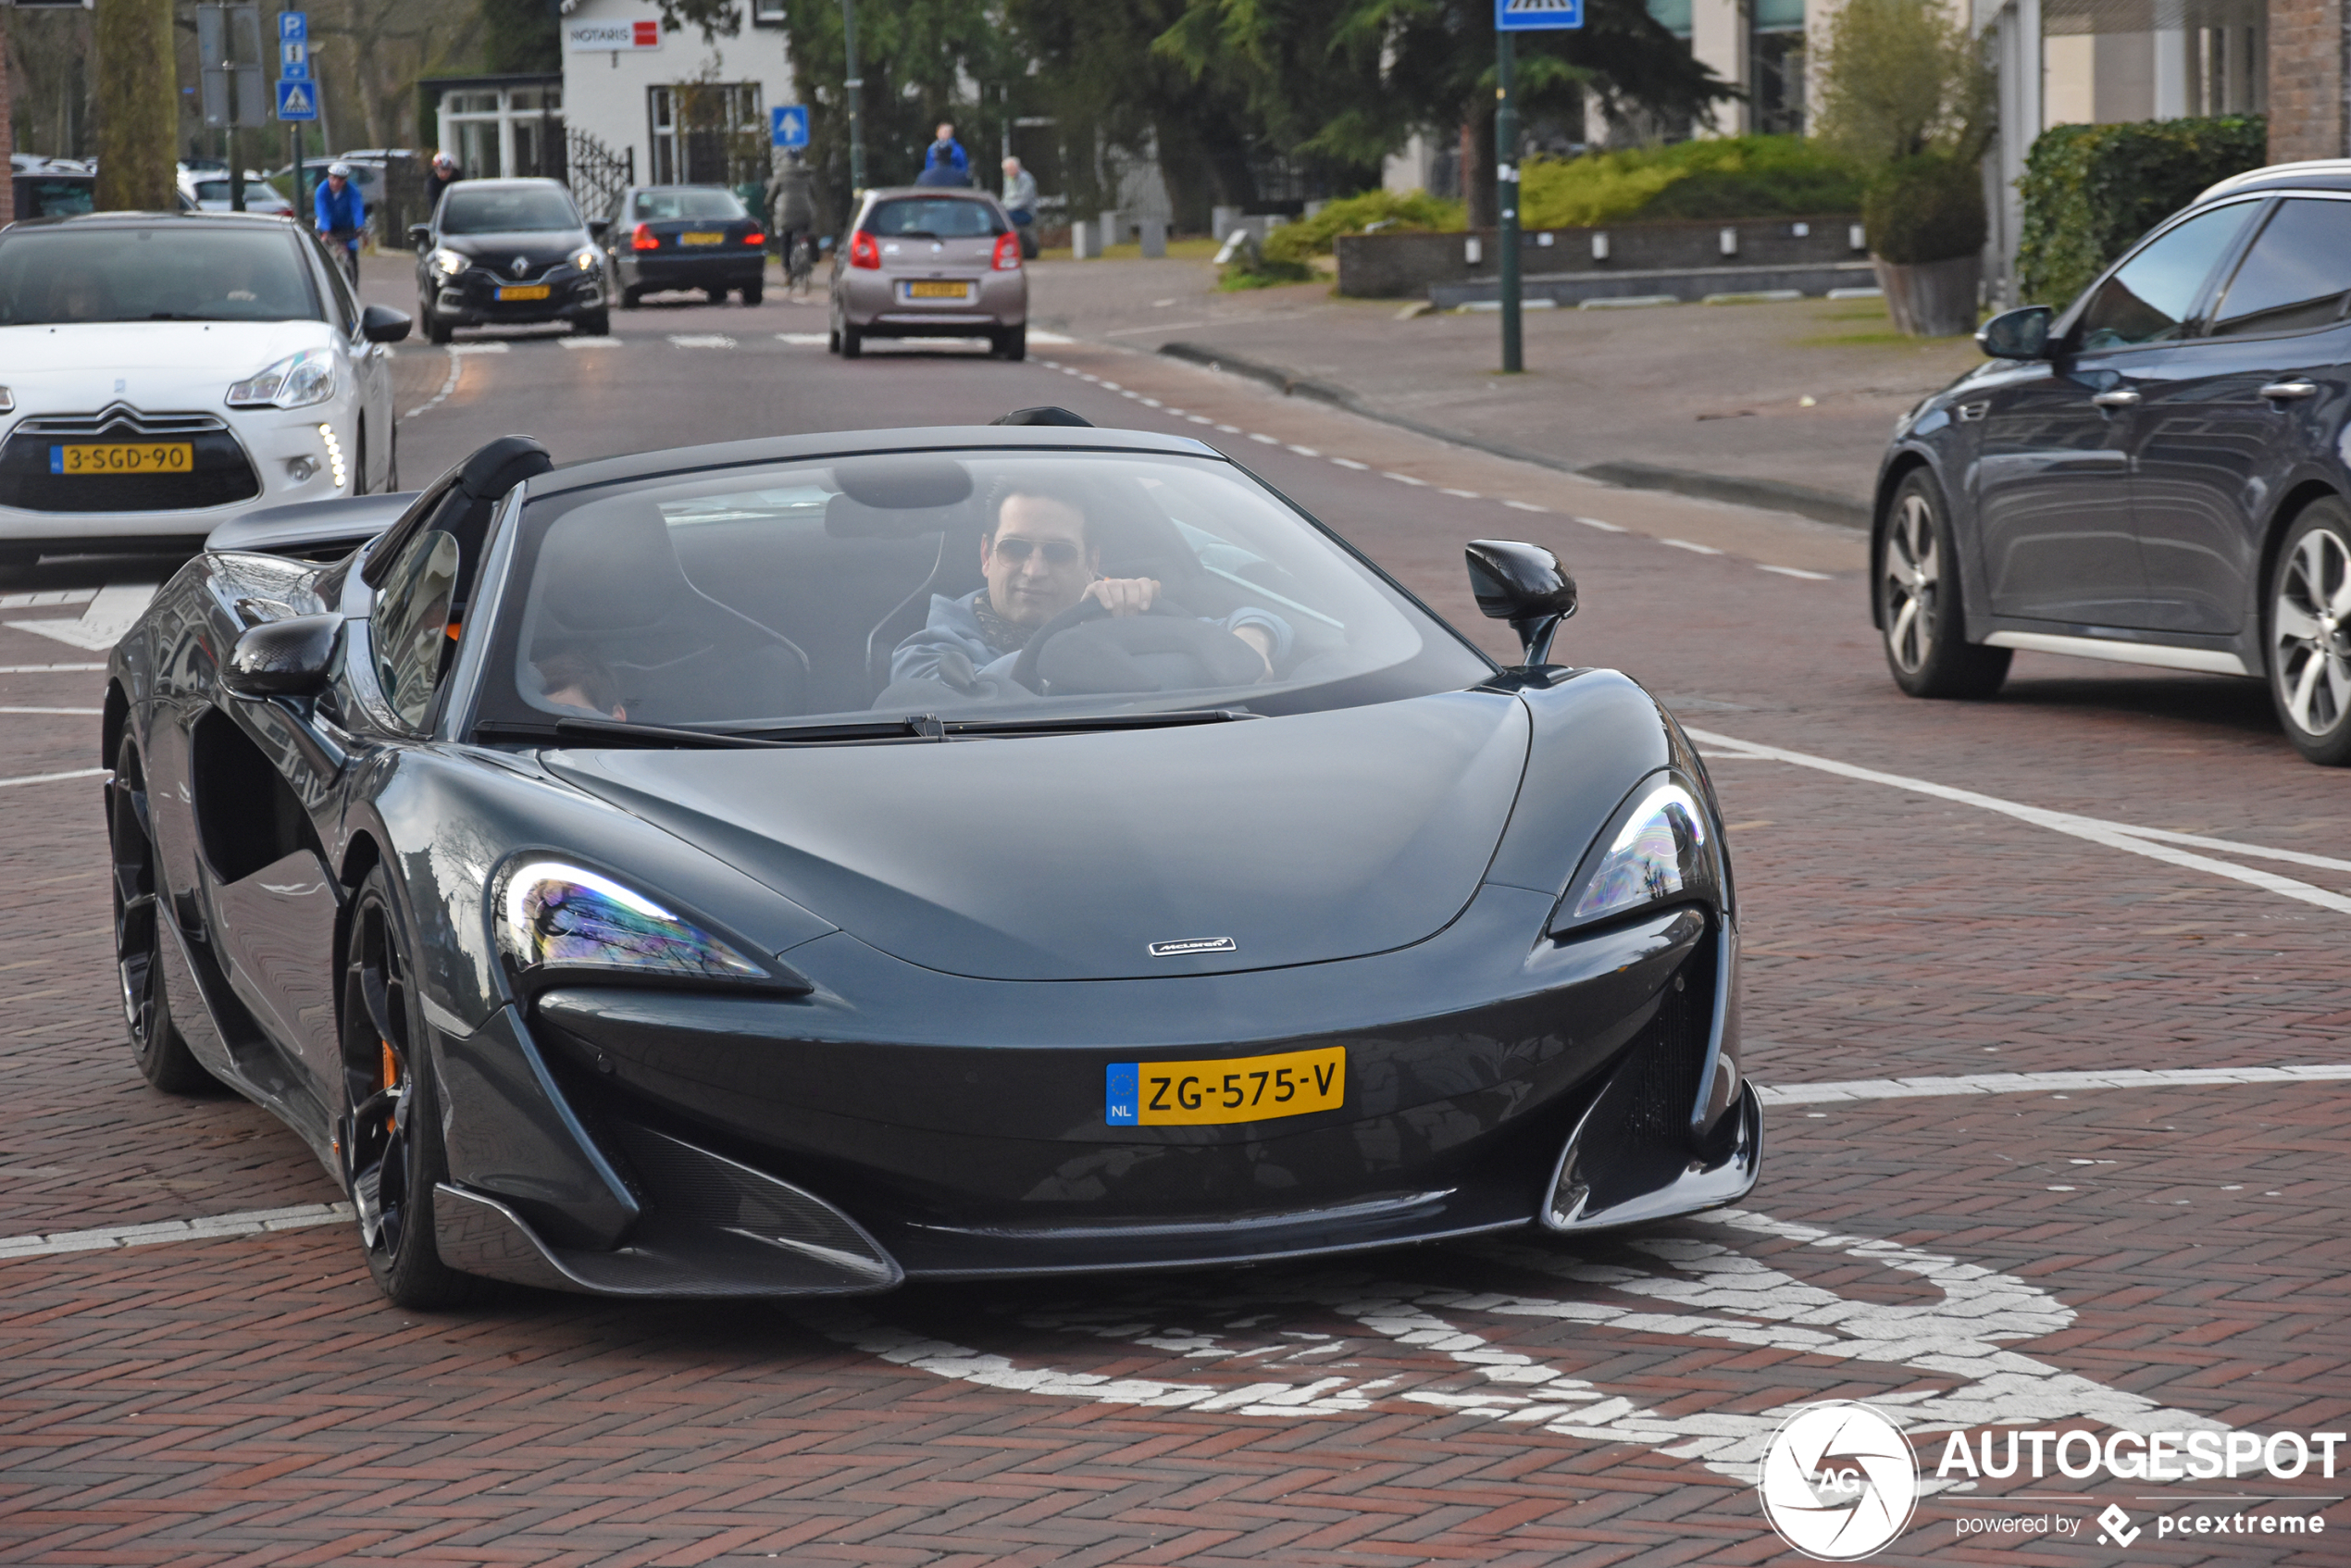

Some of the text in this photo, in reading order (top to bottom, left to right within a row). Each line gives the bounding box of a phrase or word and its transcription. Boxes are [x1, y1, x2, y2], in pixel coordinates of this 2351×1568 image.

[285, 17, 301, 37] P
[570, 29, 628, 43] NOTARIS
[68, 448, 184, 469] 3-SGD-90
[1149, 1063, 1336, 1111] ZG-575-V
[1112, 1105, 1132, 1117] NL
